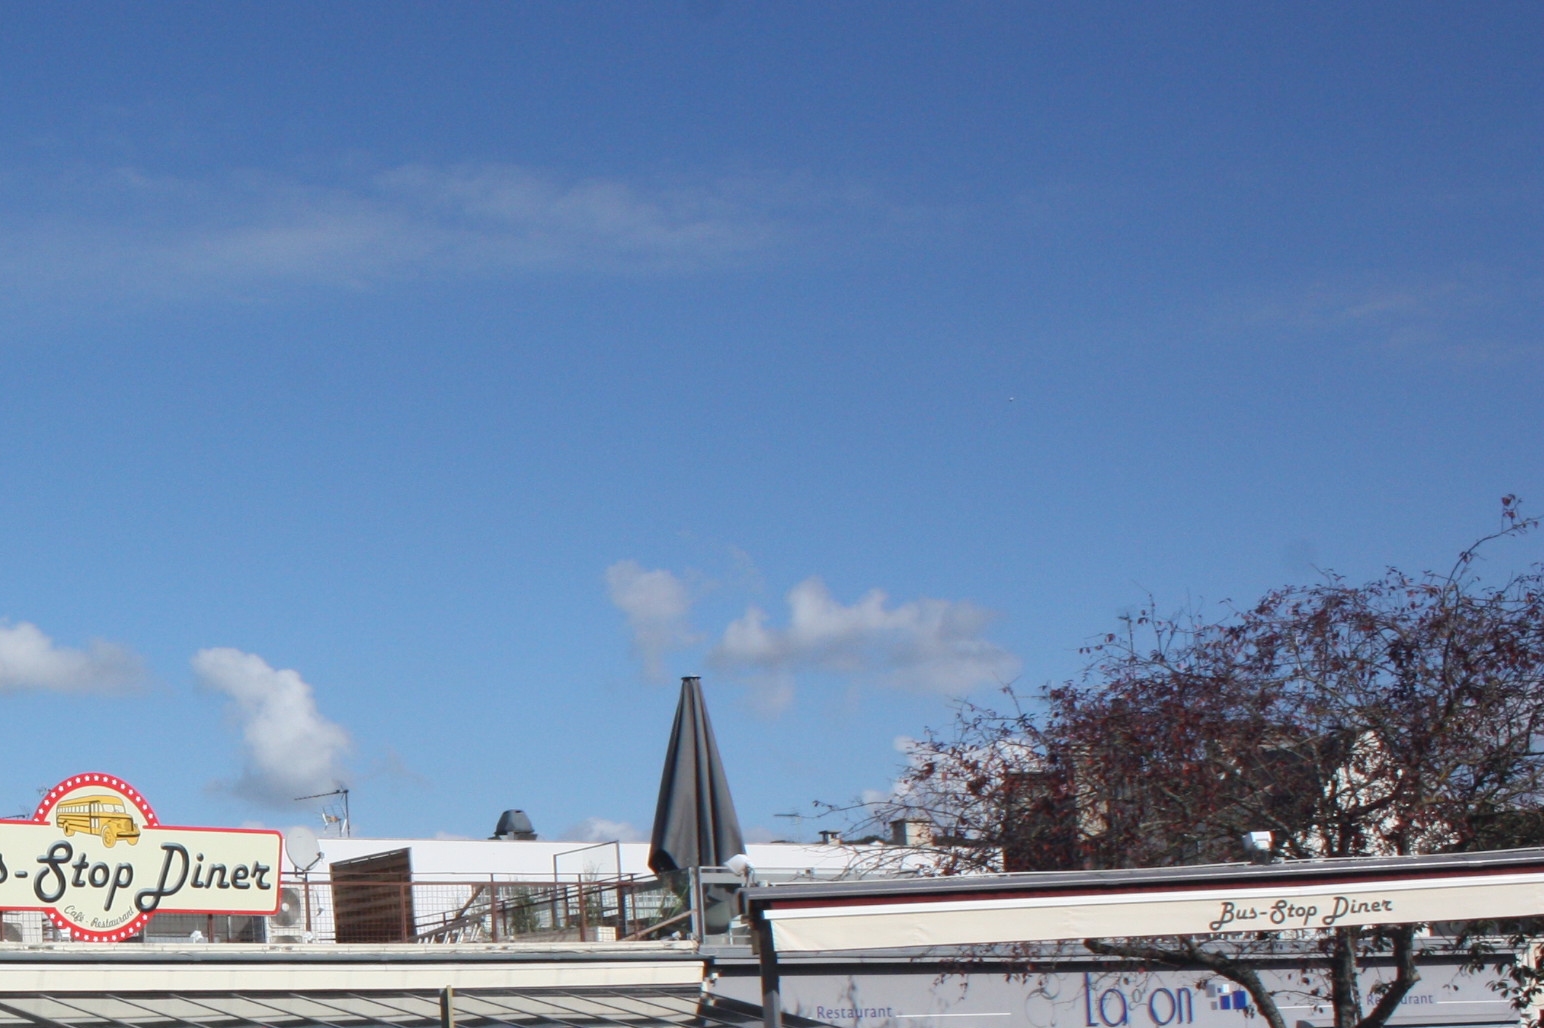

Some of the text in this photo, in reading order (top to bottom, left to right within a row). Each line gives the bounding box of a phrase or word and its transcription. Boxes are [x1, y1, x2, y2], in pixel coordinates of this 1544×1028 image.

[134, 842, 272, 913] Diner
[64, 905, 85, 923] Café
[90, 905, 134, 928] Restaurant
[1209, 896, 1393, 931] Bus-Stop Diner
[1367, 994, 1433, 1006] Reurant
[816, 1005, 892, 1019] Restaurant
